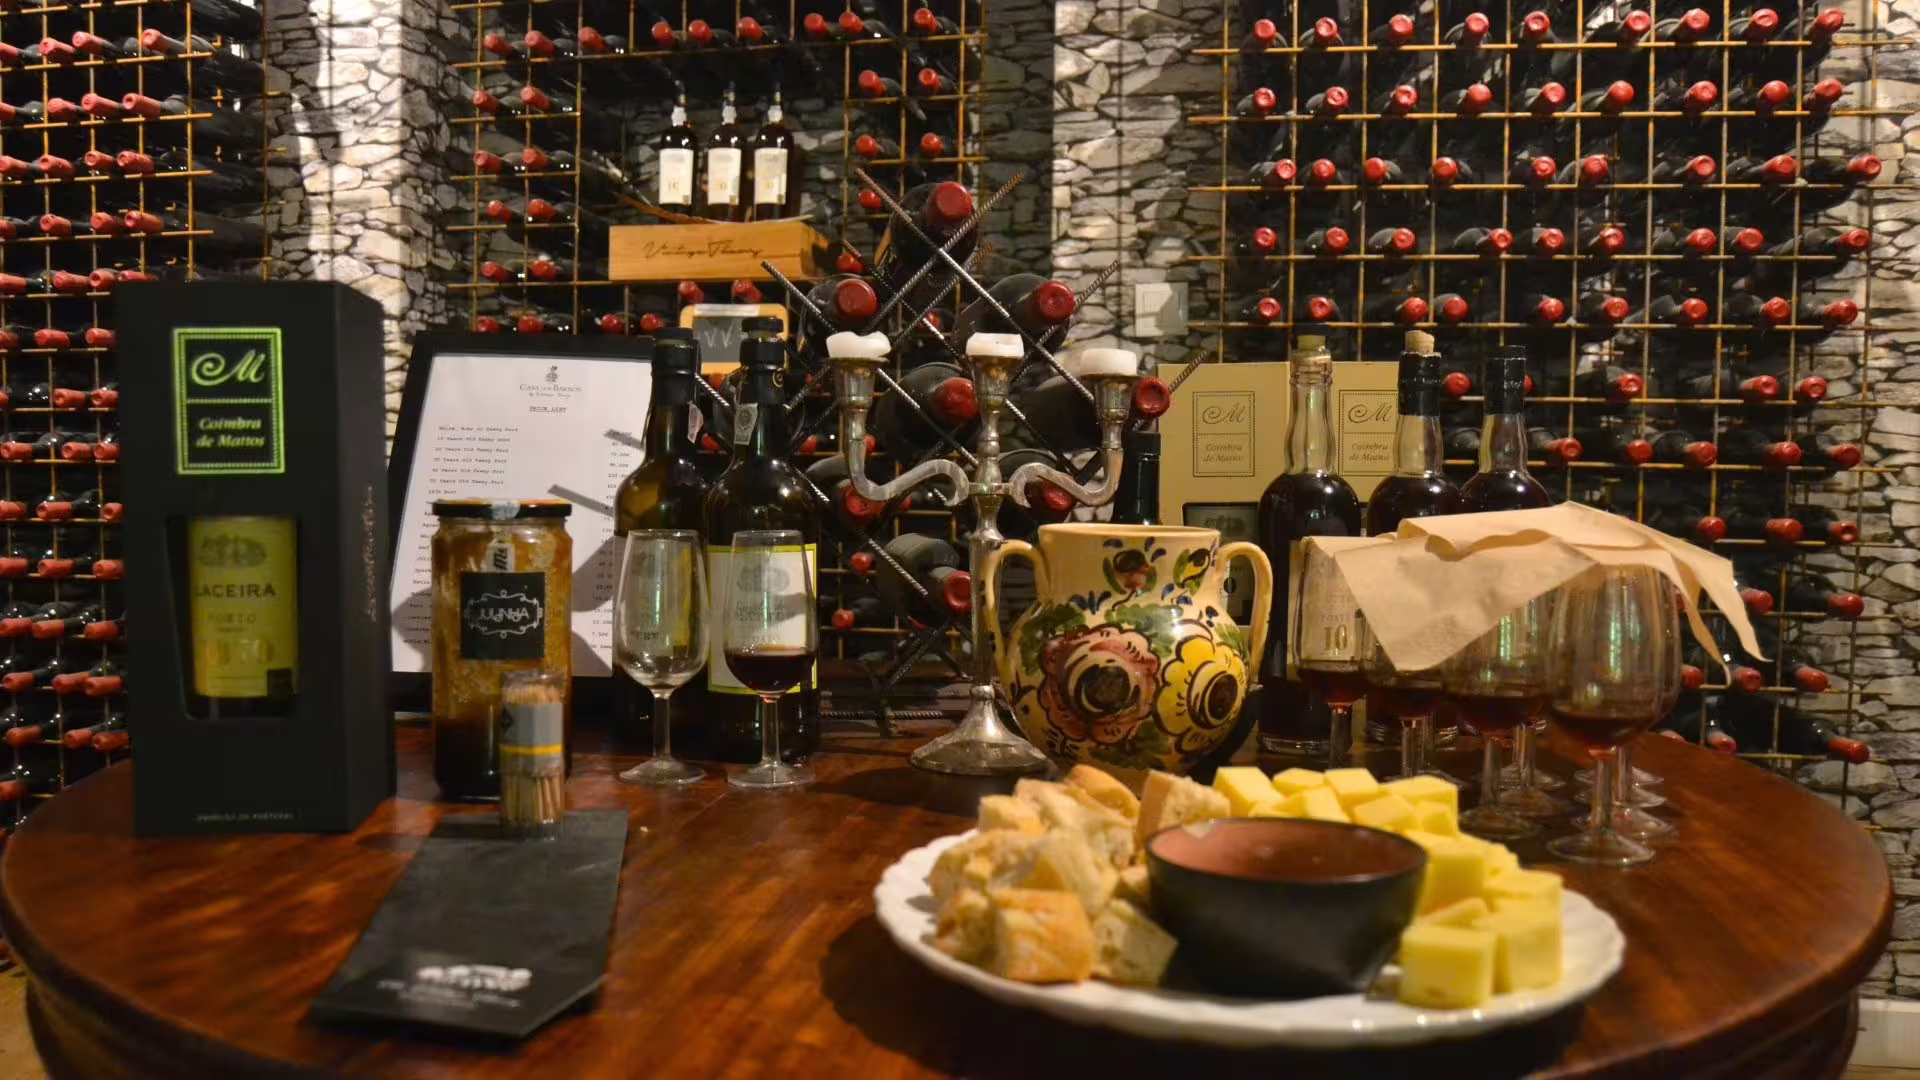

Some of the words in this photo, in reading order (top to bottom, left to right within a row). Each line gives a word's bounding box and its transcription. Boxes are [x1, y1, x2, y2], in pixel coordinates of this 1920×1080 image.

[199, 416, 262, 431] Coimbra
[196, 434, 215, 448] de
[217, 434, 266, 448] Mattos
[1323, 624, 1349, 651] 10
